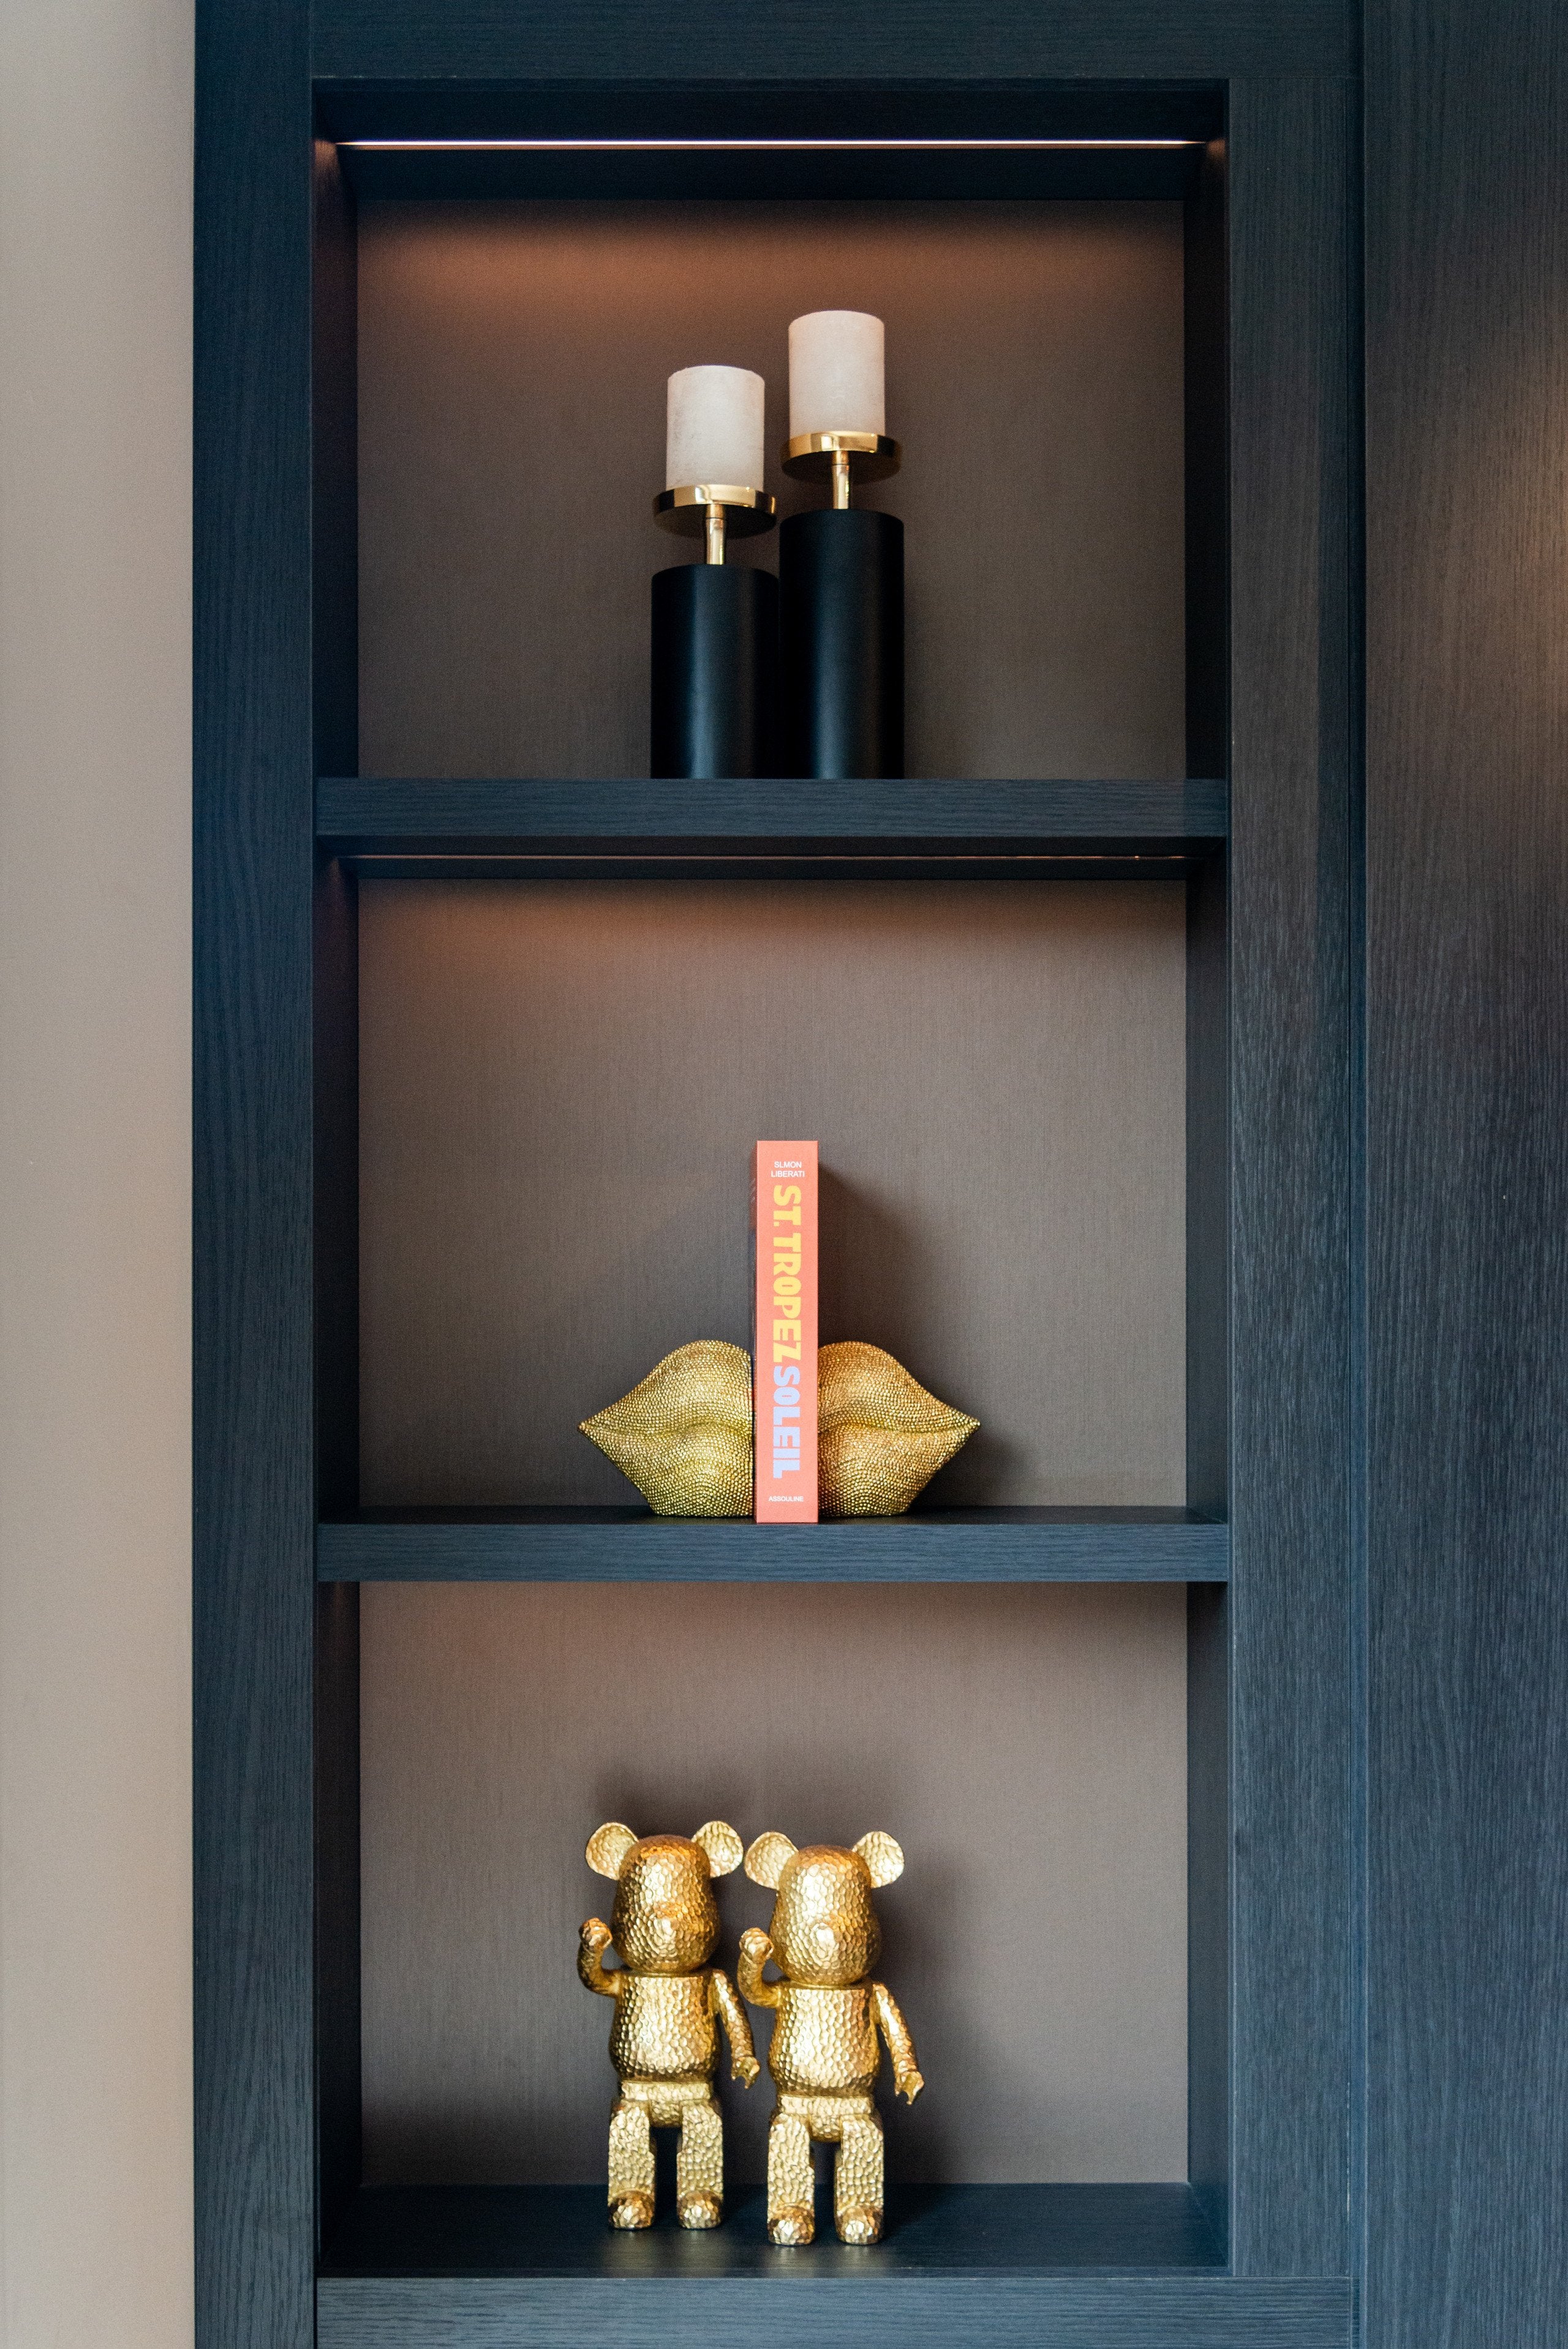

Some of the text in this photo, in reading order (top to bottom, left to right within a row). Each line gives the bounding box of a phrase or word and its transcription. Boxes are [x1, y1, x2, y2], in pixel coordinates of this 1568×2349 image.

[773, 1185, 801, 1479] ST. TROPEZ SOLEIL
